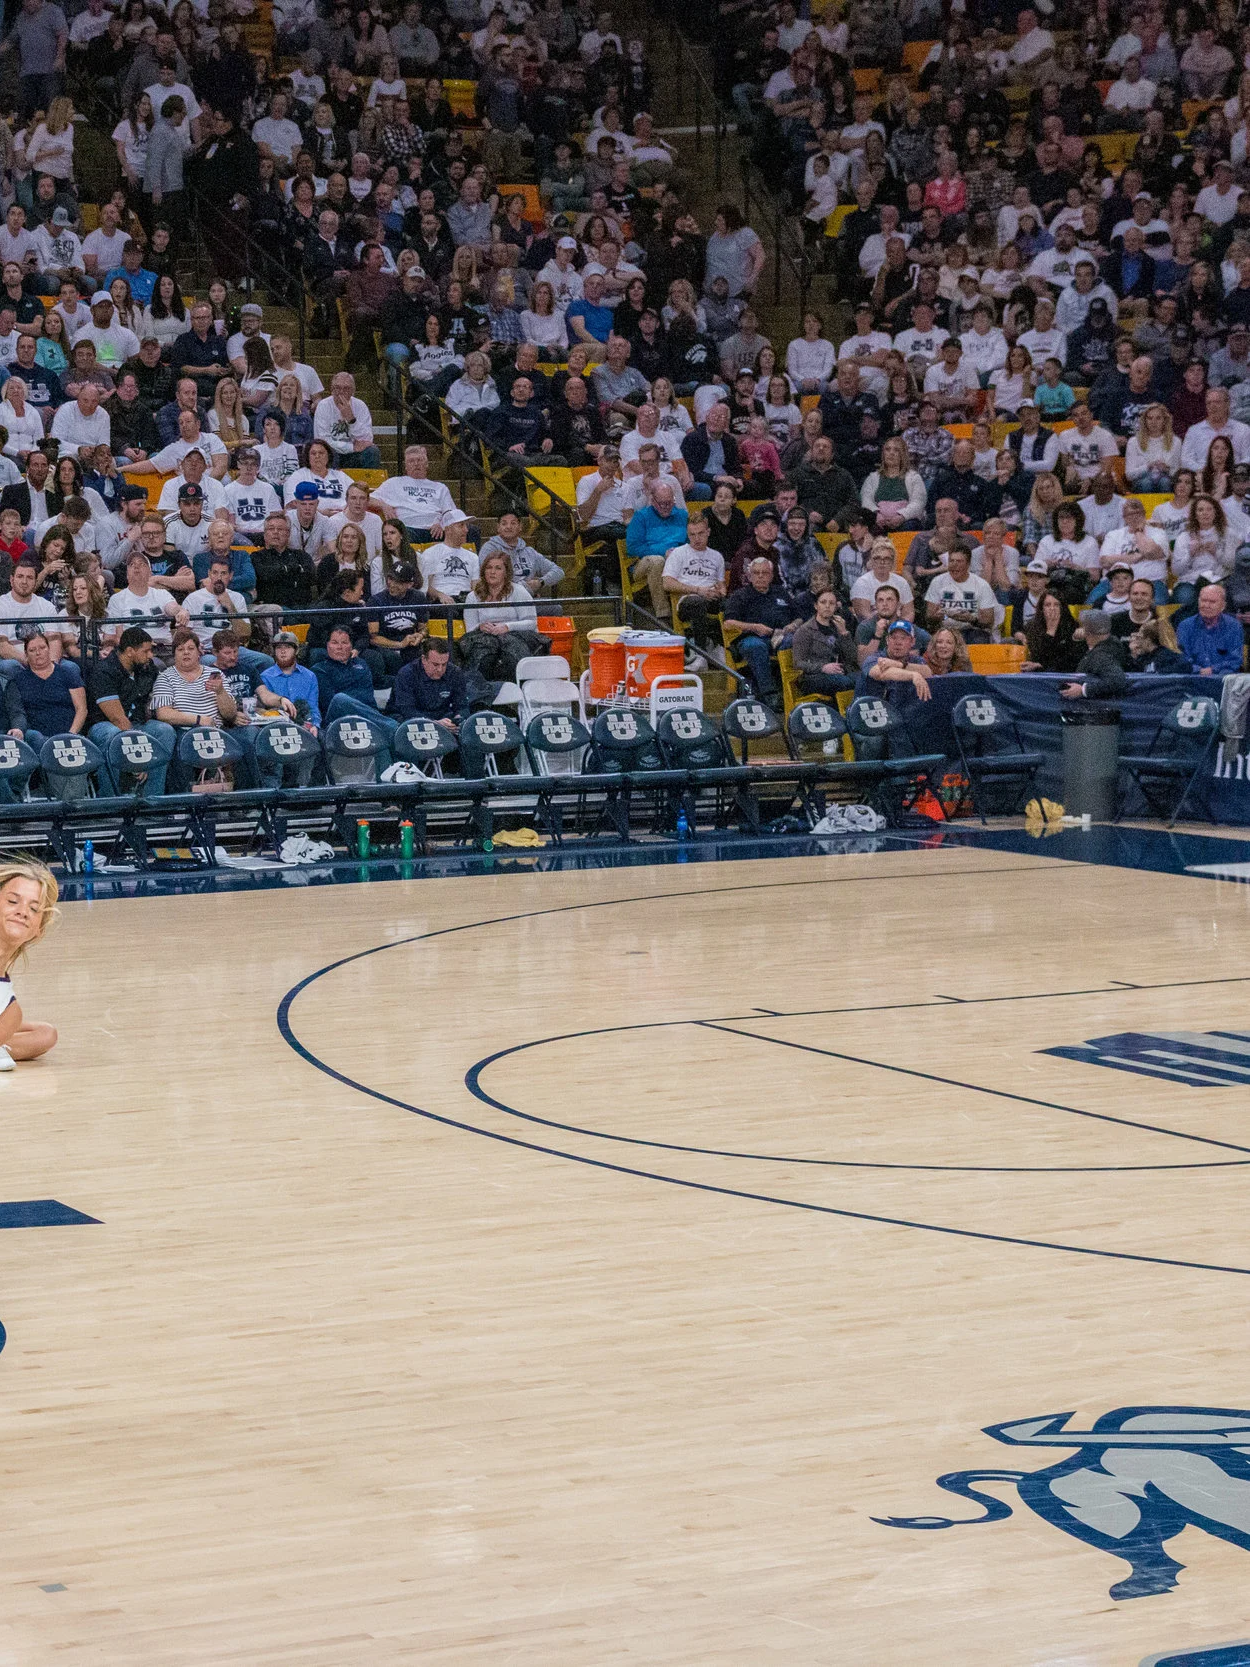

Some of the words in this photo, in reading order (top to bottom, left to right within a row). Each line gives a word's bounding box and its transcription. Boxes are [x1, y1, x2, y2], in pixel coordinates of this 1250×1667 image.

[683, 567, 711, 577] Turbo
[941, 600, 978, 609] STATE
[384, 611, 417, 620] NEVADA
[658, 695, 695, 703] GATORADE
